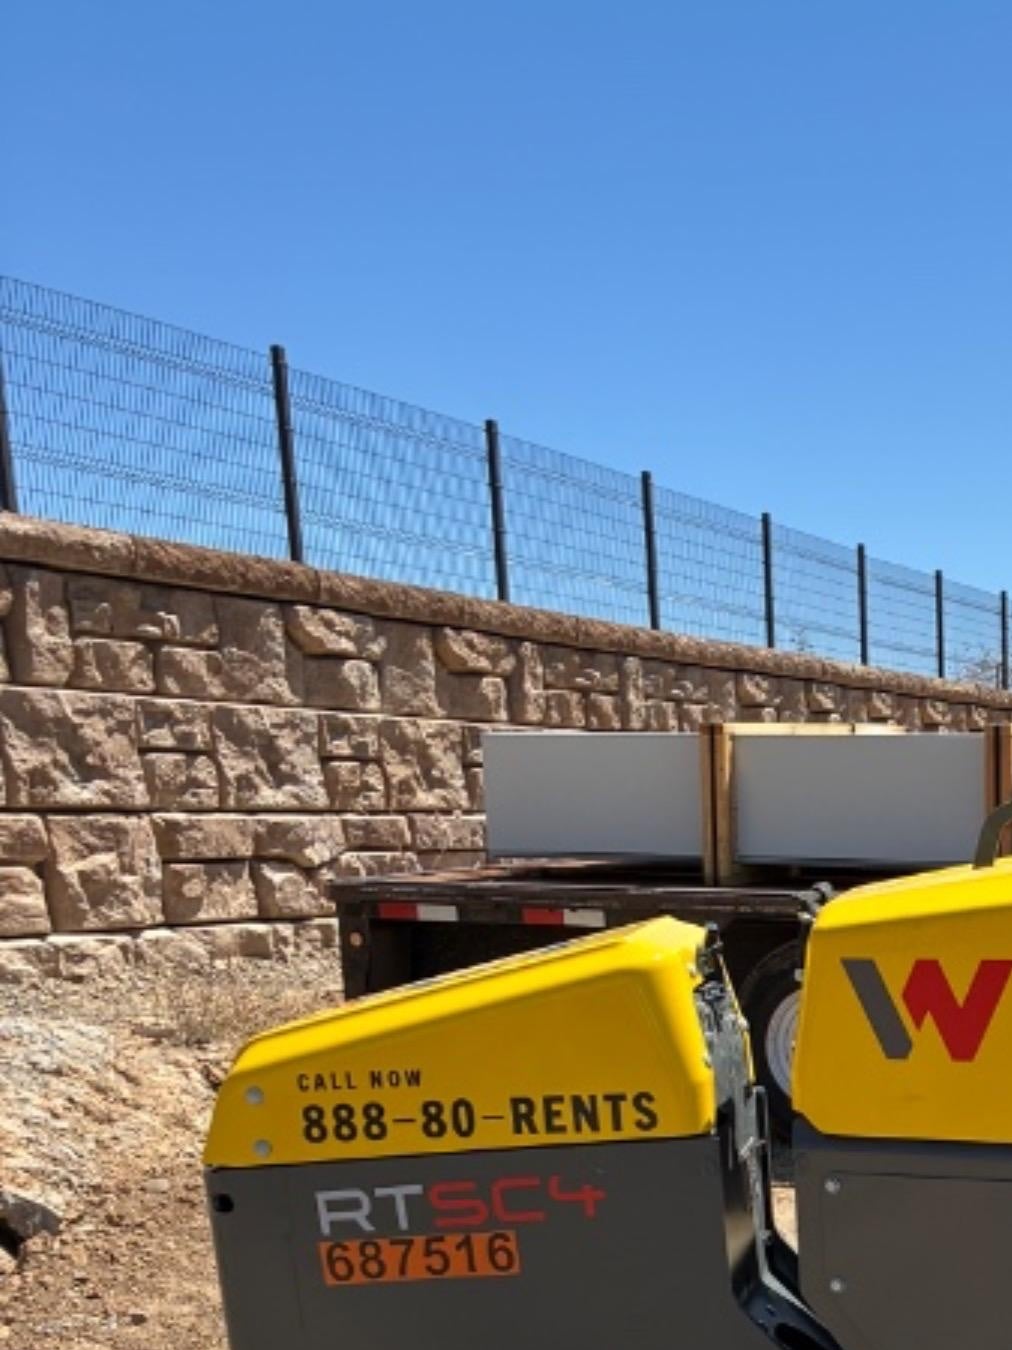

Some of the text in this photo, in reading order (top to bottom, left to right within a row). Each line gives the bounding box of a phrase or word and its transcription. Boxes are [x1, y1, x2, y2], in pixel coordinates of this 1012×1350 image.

[296, 1069, 422, 1092] CALL NOW
[302, 1091, 659, 1144] 888-80-RENTS
[325, 1231, 516, 1283] 687516
